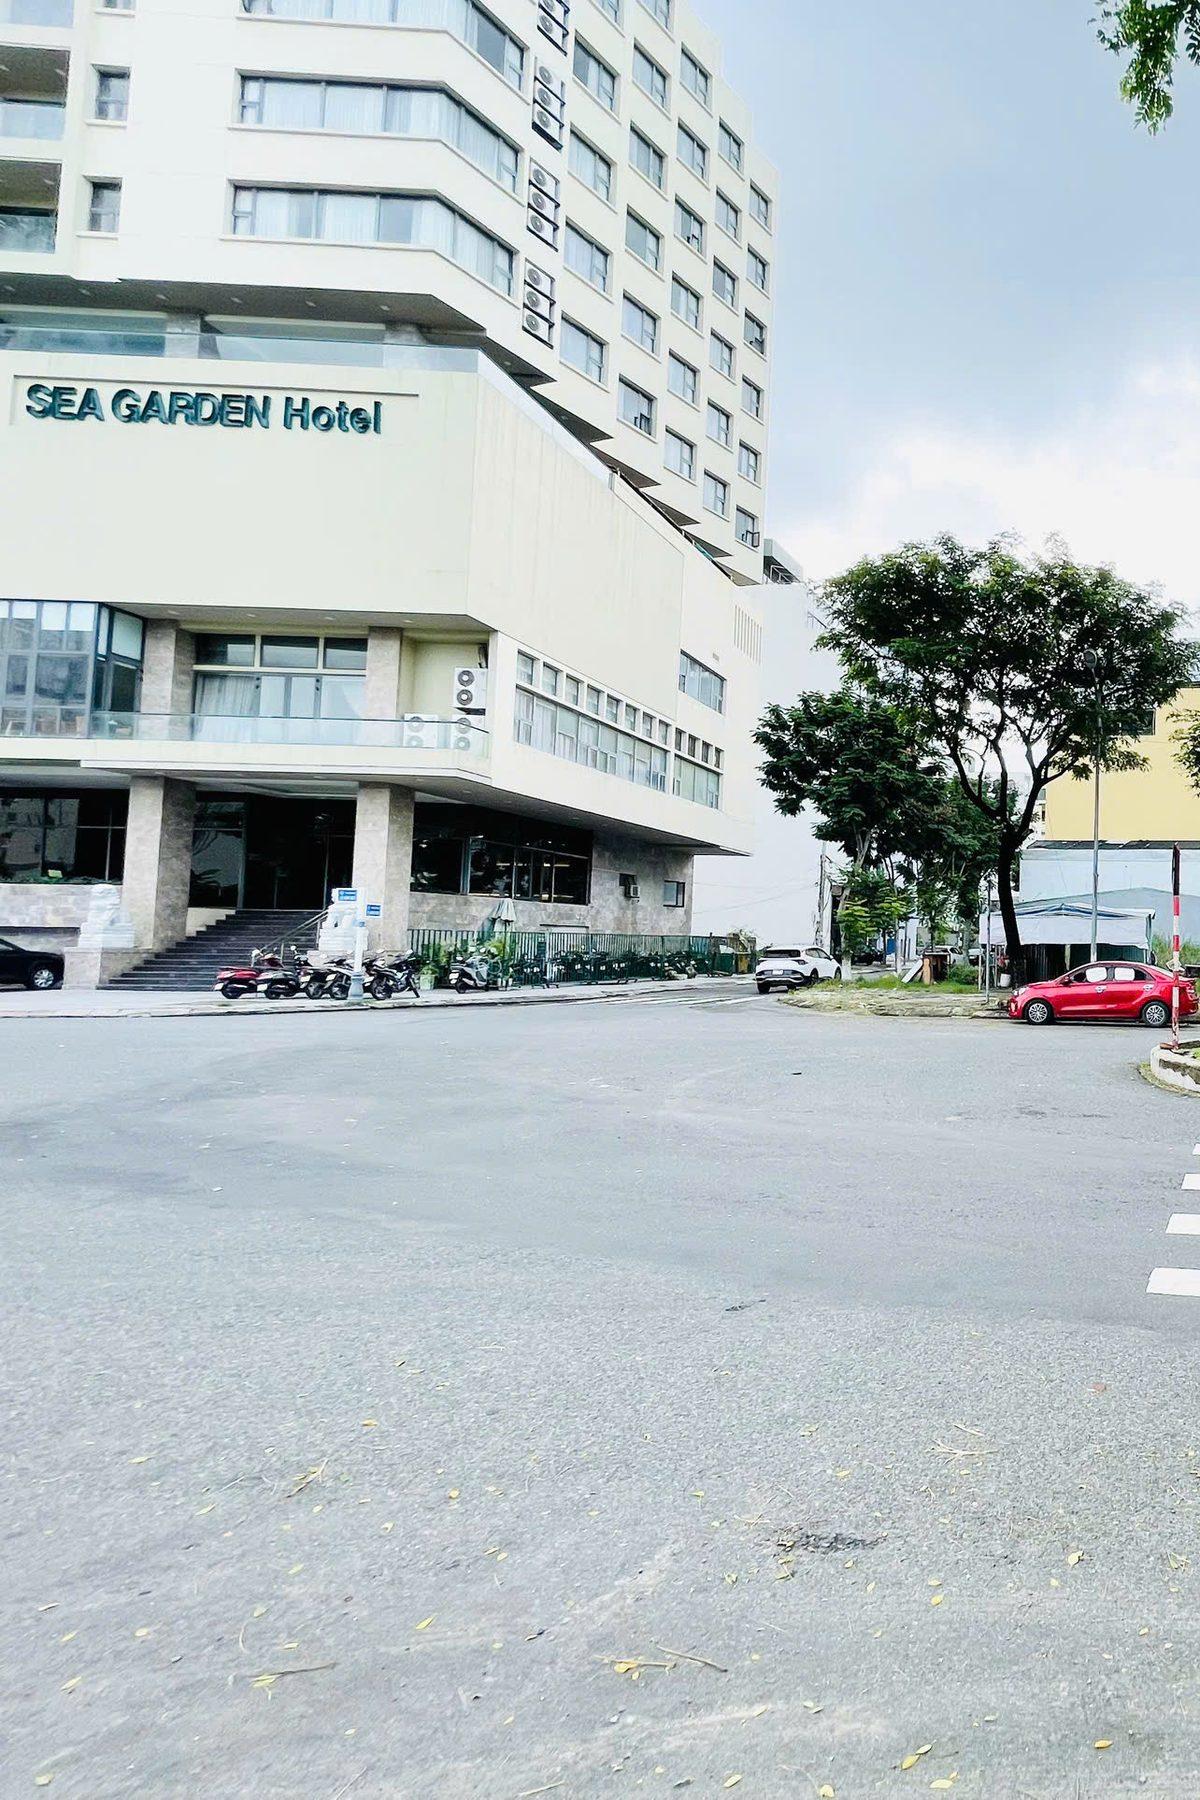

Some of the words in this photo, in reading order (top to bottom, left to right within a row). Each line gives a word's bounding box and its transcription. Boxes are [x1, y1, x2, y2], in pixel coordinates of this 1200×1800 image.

[26, 384, 104, 421] SEA
[111, 388, 270, 429] GARDEN
[283, 396, 383, 435] Hotel
